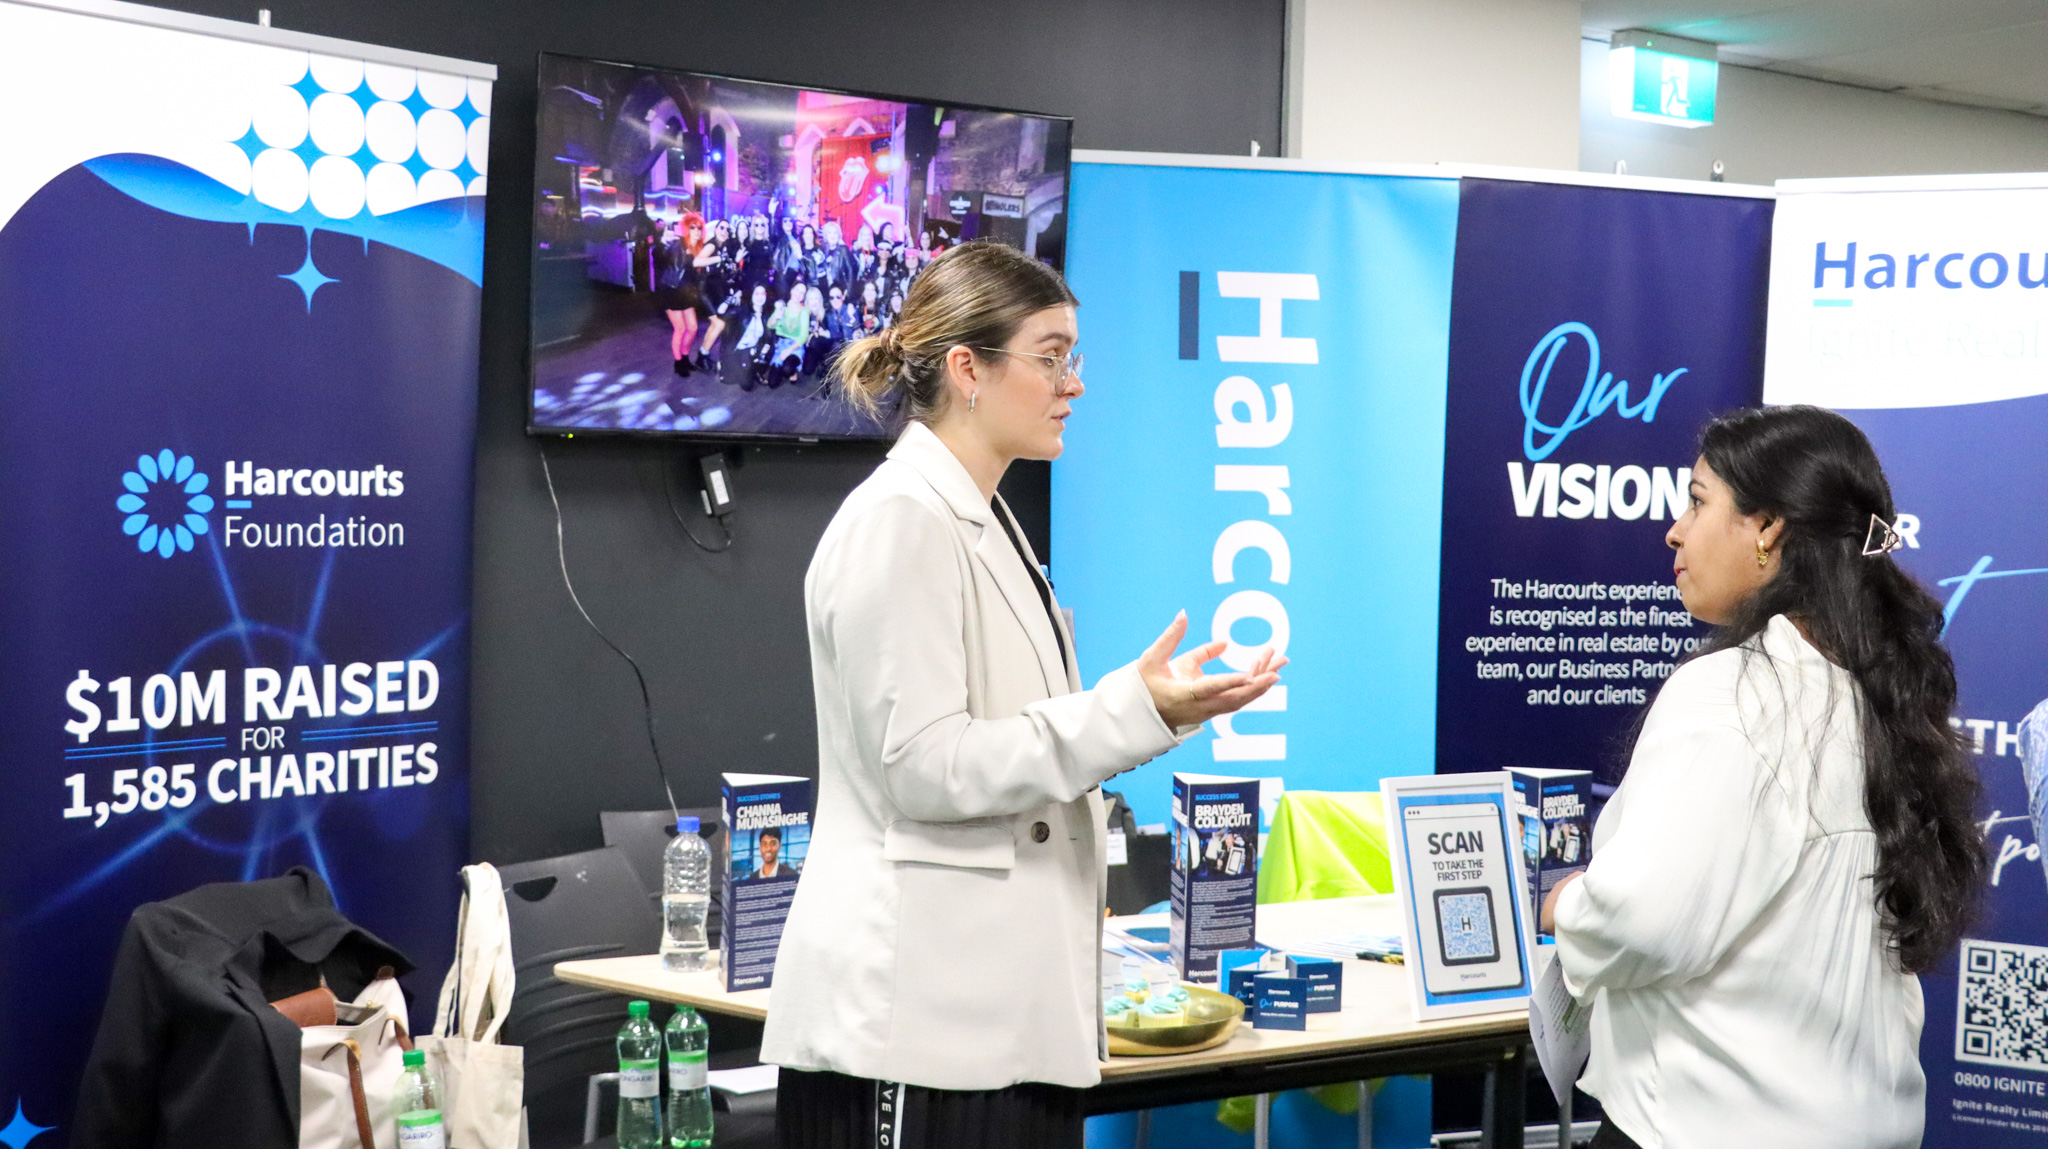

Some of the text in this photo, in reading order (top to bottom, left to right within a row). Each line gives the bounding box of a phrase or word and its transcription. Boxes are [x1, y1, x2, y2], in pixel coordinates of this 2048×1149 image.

[1518, 321, 1689, 462] Our
[225, 461, 405, 497] Harcourts
[1507, 462, 1692, 521] VISION
[225, 514, 405, 548] Foundation
[1211, 270, 1320, 828] Harcou
[1491, 578, 1682, 604] The Harcourts experienc
[1490, 604, 1693, 631] is recognised as the finest
[1465, 632, 1556, 656] experience
[1558, 632, 1575, 651] in
[1577, 632, 1608, 652] real
[1609, 634, 1659, 652] estate
[1661, 632, 1682, 657] by
[1477, 659, 1675, 681] team, our Business Partn
[64, 659, 440, 743] $10M RAISED
[1527, 684, 1646, 705] and our clients
[241, 726, 285, 751] FOR
[63, 742, 439, 828] 1,585 CHARITIES
[736, 803, 782, 819] CHANNA
[1195, 803, 1244, 817] BRAYDEN
[1542, 804, 1586, 820] COLDICUTT
[1543, 794, 1579, 808] BRAYDEN
[736, 812, 809, 831] MUNASINGHE
[1194, 813, 1252, 829] COLDICUTT
[1427, 830, 1484, 856] SCAN
[1432, 859, 1485, 871] TO TAKE THE
[1437, 870, 1482, 882] FIRST STEP
[1188, 970, 1217, 978] Harcourt
[1954, 1071, 2046, 1097] 0800 IGNITE
[1952, 1098, 1983, 1111] Ignite
[1985, 1102, 2019, 1117] Realty
[401, 1131, 433, 1141] GARIRO
